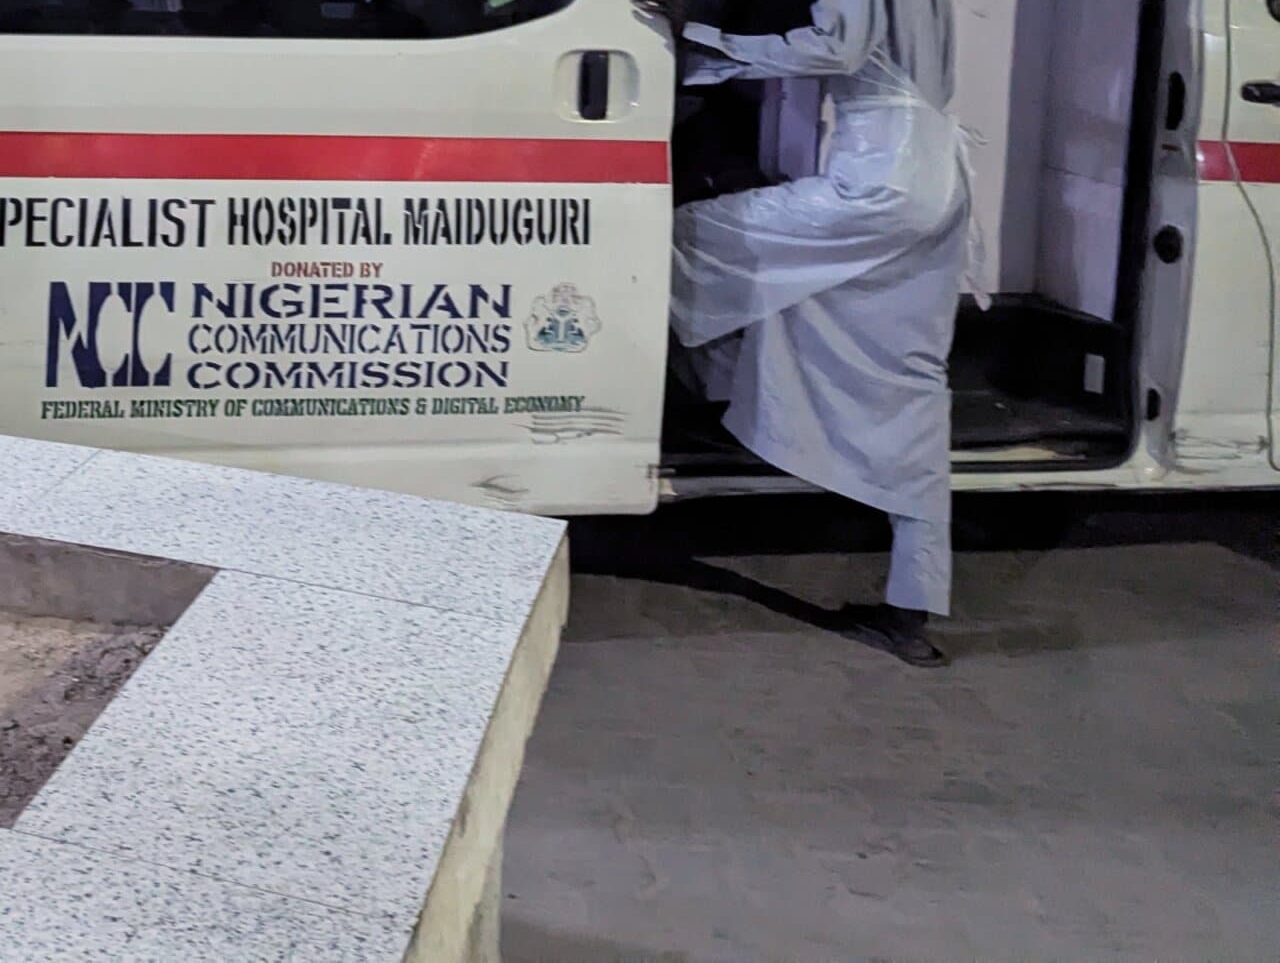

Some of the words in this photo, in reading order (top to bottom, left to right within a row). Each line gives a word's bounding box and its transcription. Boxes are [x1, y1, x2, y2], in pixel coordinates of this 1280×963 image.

[227, 197, 393, 246] HOSPITAL
[403, 197, 591, 246] MAIDUGURI
[271, 261, 355, 279] DONATED
[359, 261, 384, 278] BY
[191, 283, 513, 319] NIGERIAN
[45, 281, 176, 388] NCC
[188, 323, 512, 355] COMMUNICATIONS
[187, 360, 509, 389] COMMISSION
[41, 400, 125, 420] FEDERAL
[130, 399, 220, 418] MINISTRY
[224, 398, 247, 417] OF
[251, 397, 410, 417] COMMUNICATIONS
[431, 396, 498, 415] DIGITAL
[504, 395, 585, 414] ECONOMY
